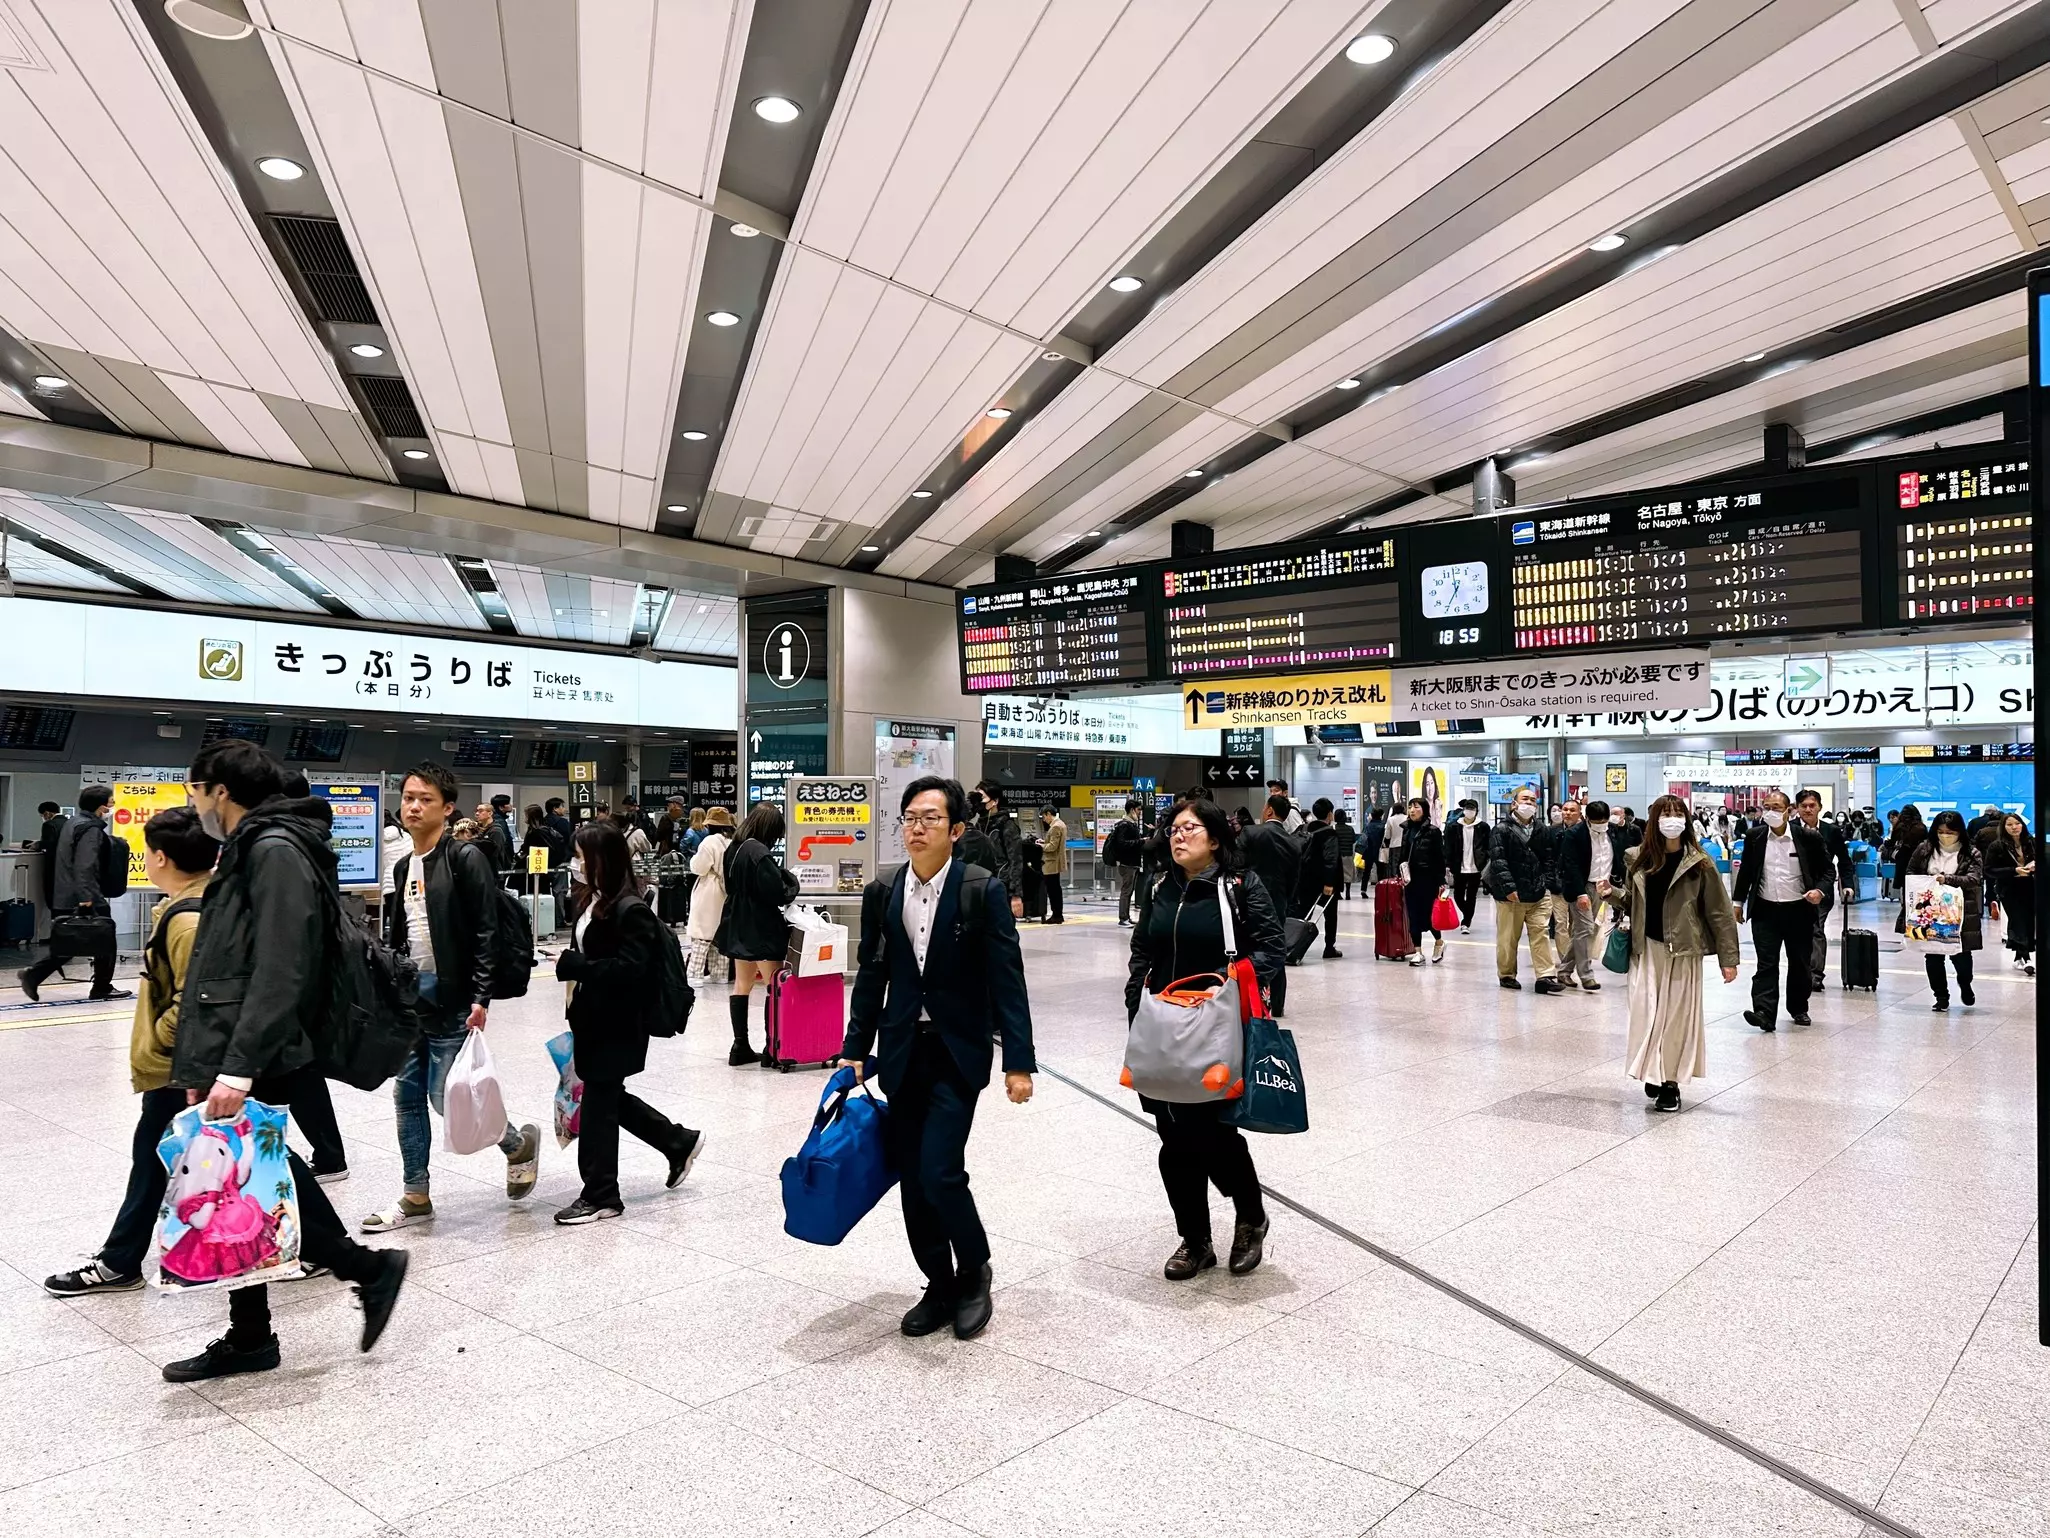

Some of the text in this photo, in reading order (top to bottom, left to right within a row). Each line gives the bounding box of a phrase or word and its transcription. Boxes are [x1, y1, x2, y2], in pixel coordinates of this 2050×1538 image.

[1961, 469, 1971, 498] 名古屋
[1980, 467, 1990, 496] 三河安城
[2005, 463, 2016, 493] 浜松
[2018, 462, 2029, 492] 掛川
[1937, 473, 1946, 501] 米原
[1637, 493, 1762, 520] 名古屋・東京 方面
[1539, 513, 1611, 532] 東海道新幹線
[1638, 521, 1651, 531] for
[1652, 516, 1690, 529] Nagoya,
[1568, 526, 1608, 537] Shinkansen
[1708, 531, 1730, 540] のりば
[1595, 550, 1619, 558] Departure
[1640, 545, 1668, 553] Destination
[1030, 579, 1119, 600] 岡山・博多・鹿児島中央
[1439, 627, 1480, 645] 18 59
[274, 642, 513, 688] きっぷうりば
[533, 670, 582, 686] Tickets
[1410, 661, 1706, 697] 新大阪駅までのきっぷが必要です
[1225, 684, 1386, 711] 新幹線のりかえ改札
[1410, 690, 1659, 712] A ticket to Shin-Ōsaka station is required.
[1232, 708, 1347, 724] Shinkansen Tracks
[1233, 743, 1253, 752] うりば
[574, 765, 587, 779] B
[880, 775, 888, 785] 2F
[1676, 770, 1686, 778] 20
[1688, 769, 1697, 777] 21
[1700, 769, 1709, 777] 22
[1733, 769, 1743, 777] 23
[1745, 768, 1755, 776] 24
[1758, 768, 1768, 776] 25
[1770, 768, 1780, 776] 26
[1783, 767, 1793, 776] 27
[122, 786, 157, 796] こちらは
[1135, 779, 1143, 789] A
[1146, 779, 1154, 789] A
[578, 783, 590, 803] 入口
[798, 784, 866, 801] えきねっと
[1148, 791, 1155, 806] 入口
[804, 806, 861, 816] 青色の券売機で
[880, 809, 888, 818] 1F
[340, 838, 370, 847] えきねっと
